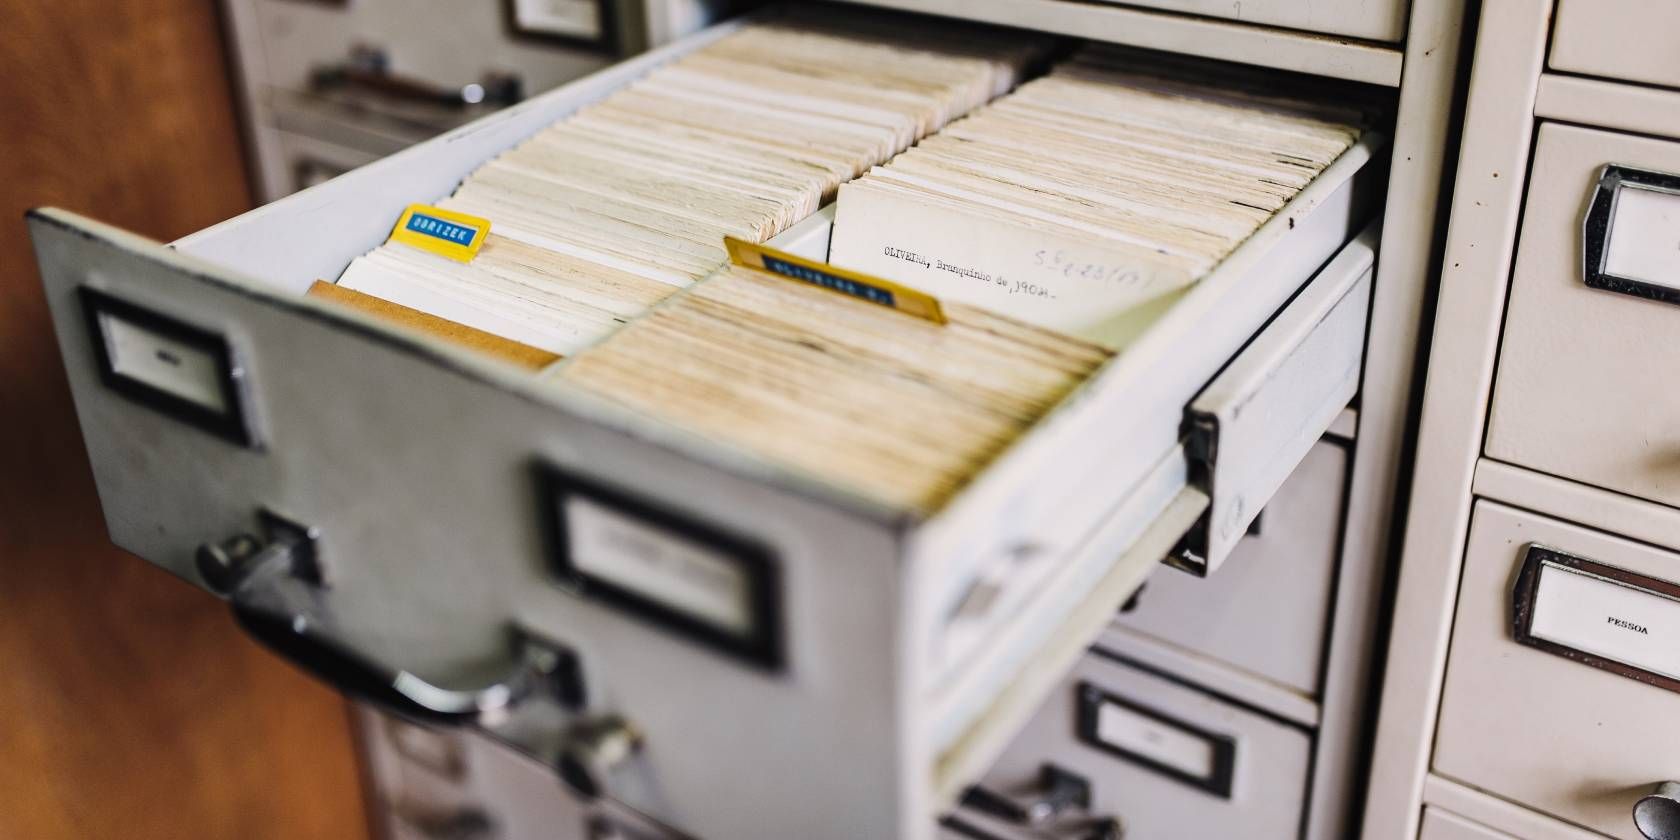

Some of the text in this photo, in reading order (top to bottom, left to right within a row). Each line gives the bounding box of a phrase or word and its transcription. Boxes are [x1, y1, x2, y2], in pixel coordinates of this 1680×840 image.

[884, 246, 931, 269] OLIVEIRA,
[936, 259, 992, 282] Branquinho
[1607, 616, 1648, 635] PESSOA
